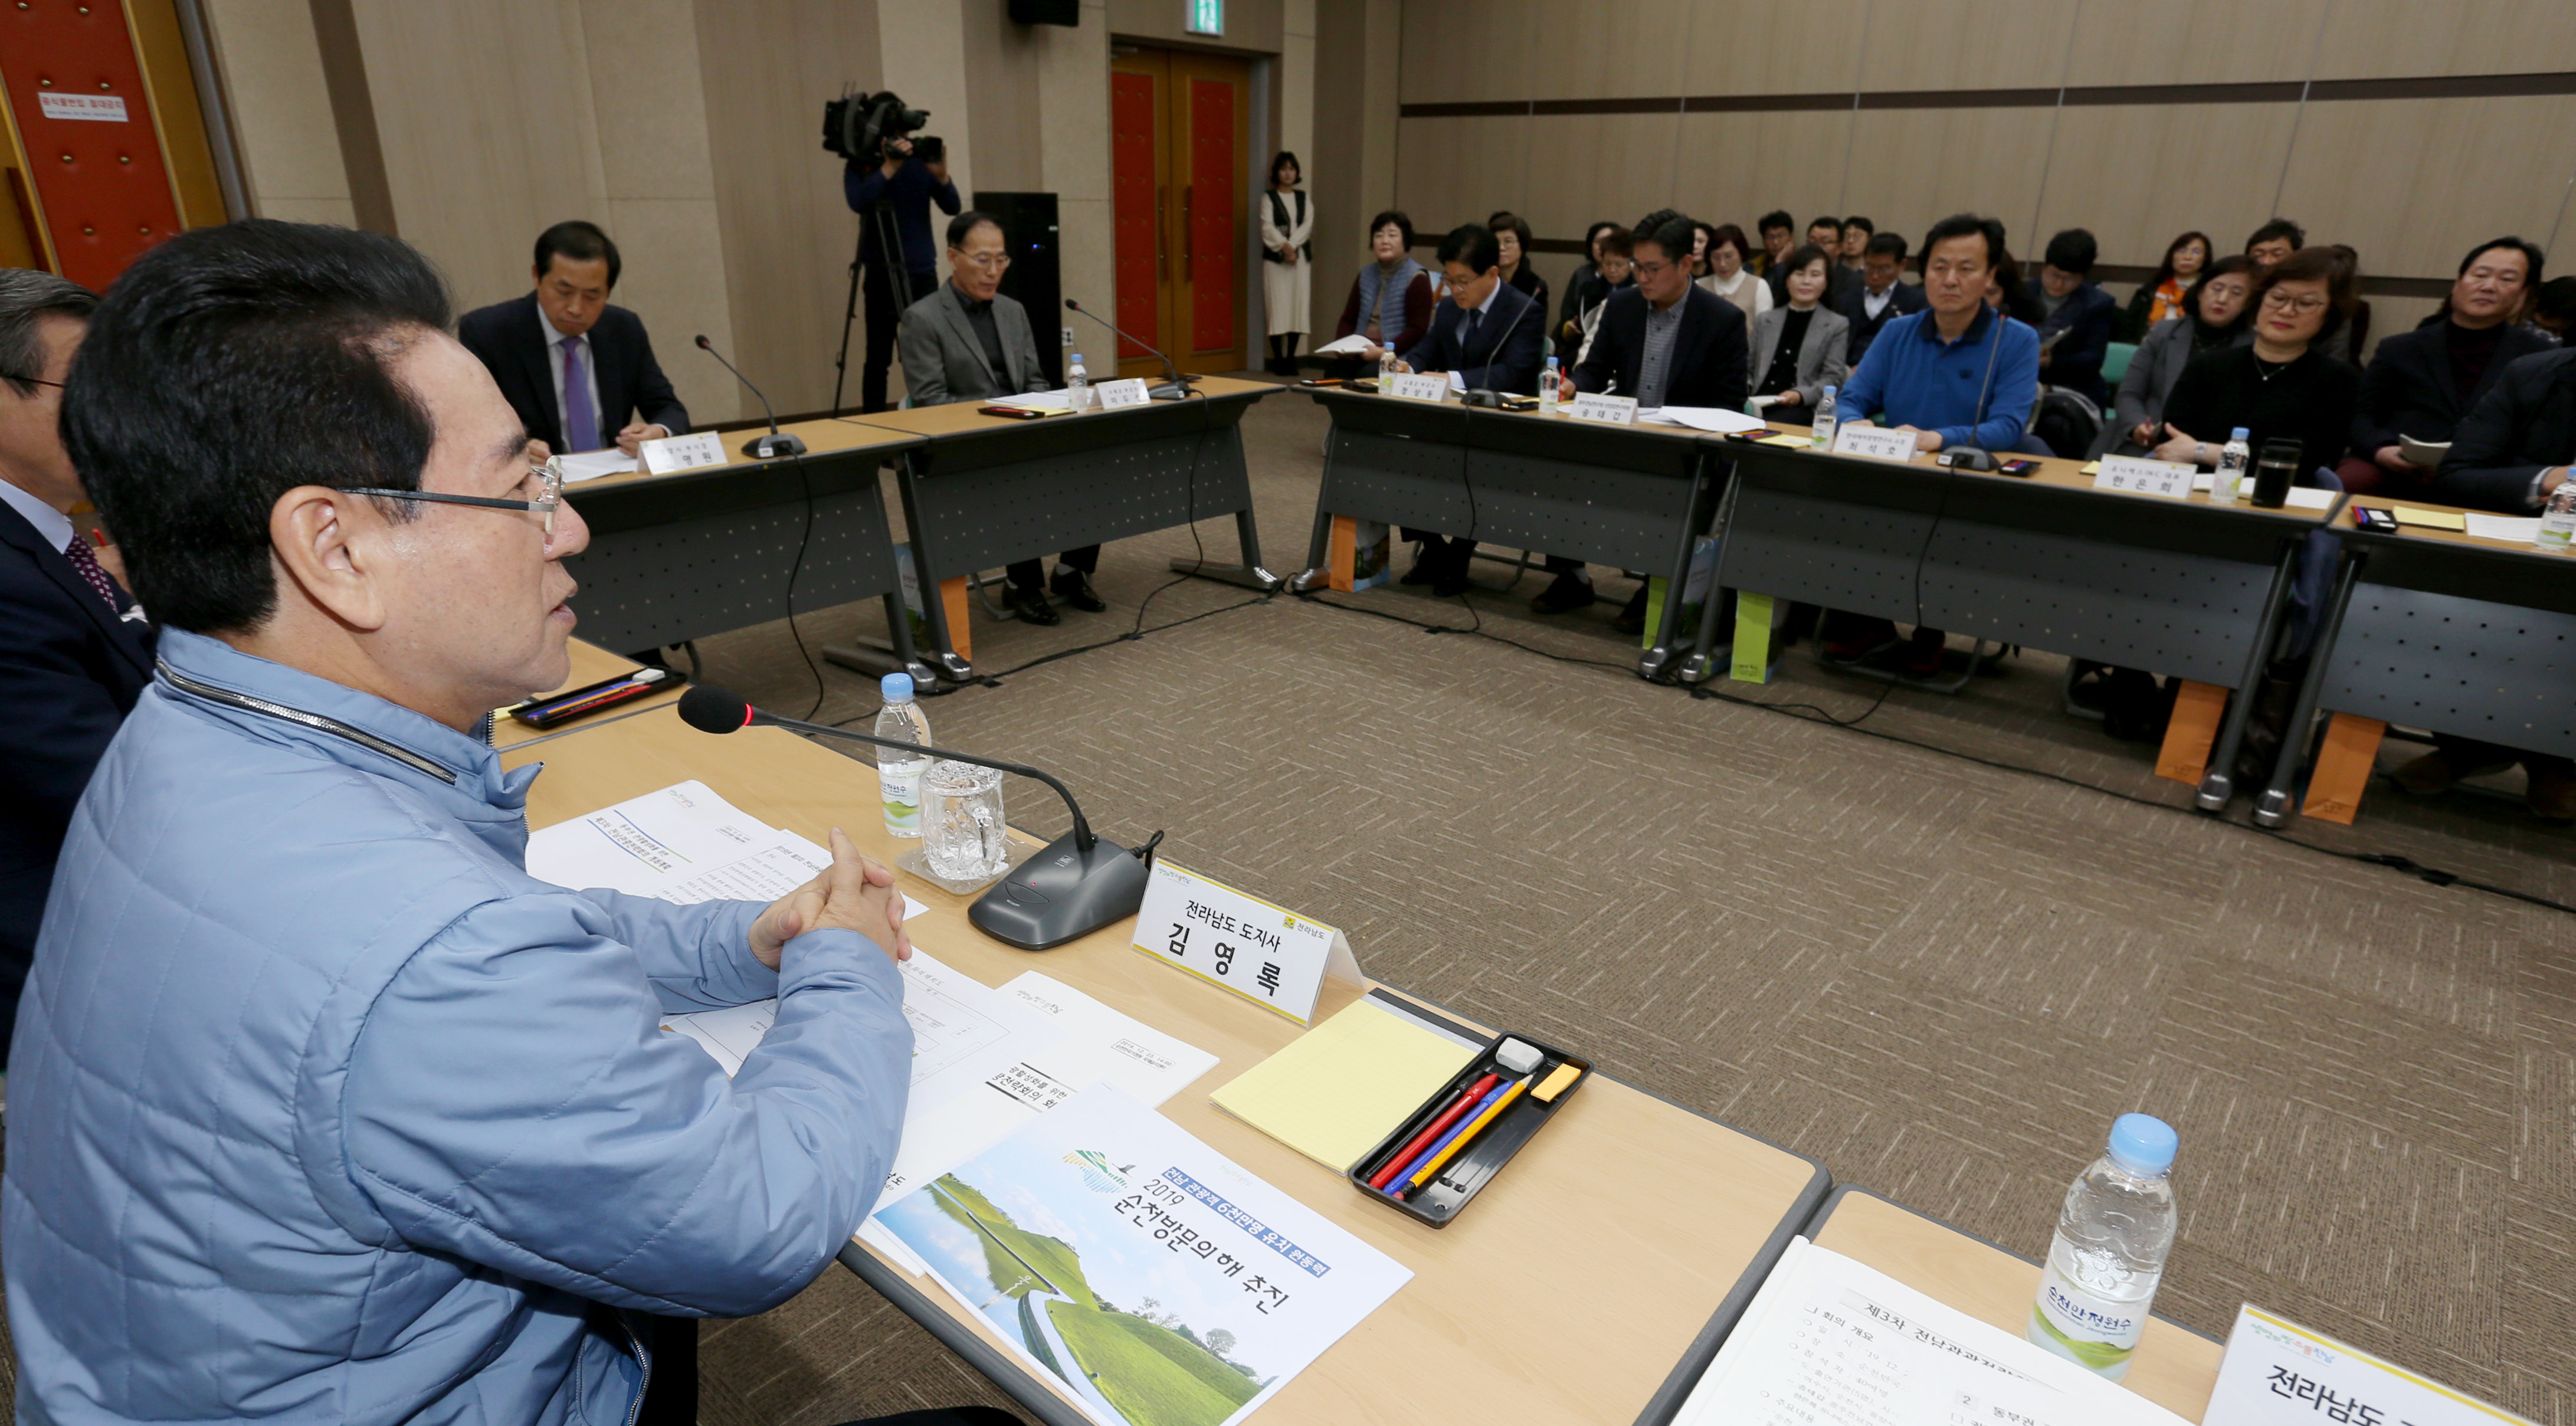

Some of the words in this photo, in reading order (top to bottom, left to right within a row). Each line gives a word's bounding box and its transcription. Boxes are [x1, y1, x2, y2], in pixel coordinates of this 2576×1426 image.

[1185, 899, 1236, 934] 전라남도
[1239, 923, 1281, 953] 도지사
[1297, 923, 1325, 940] 전라남도
[1168, 922, 1190, 956] 김
[1214, 941, 1235, 975] 영
[1257, 962, 1280, 996] 록
[1143, 1179, 1185, 1207] 2019
[1164, 1168, 1189, 1187] 전남
[1185, 1182, 1220, 1207] 관광객
[1217, 1202, 1266, 1235] 6천만명
[1262, 1232, 1291, 1253] 유치
[1289, 1248, 1328, 1277] 원동력
[1243, 1275, 1289, 1315] 추진
[2048, 1286, 2131, 1330] 순천만정원수
[1821, 1311, 1846, 1328] 회의
[1850, 1325, 1874, 1342] 개요
[1864, 1303, 1906, 1331] 제3차
[1962, 1395, 1972, 1405] 2
